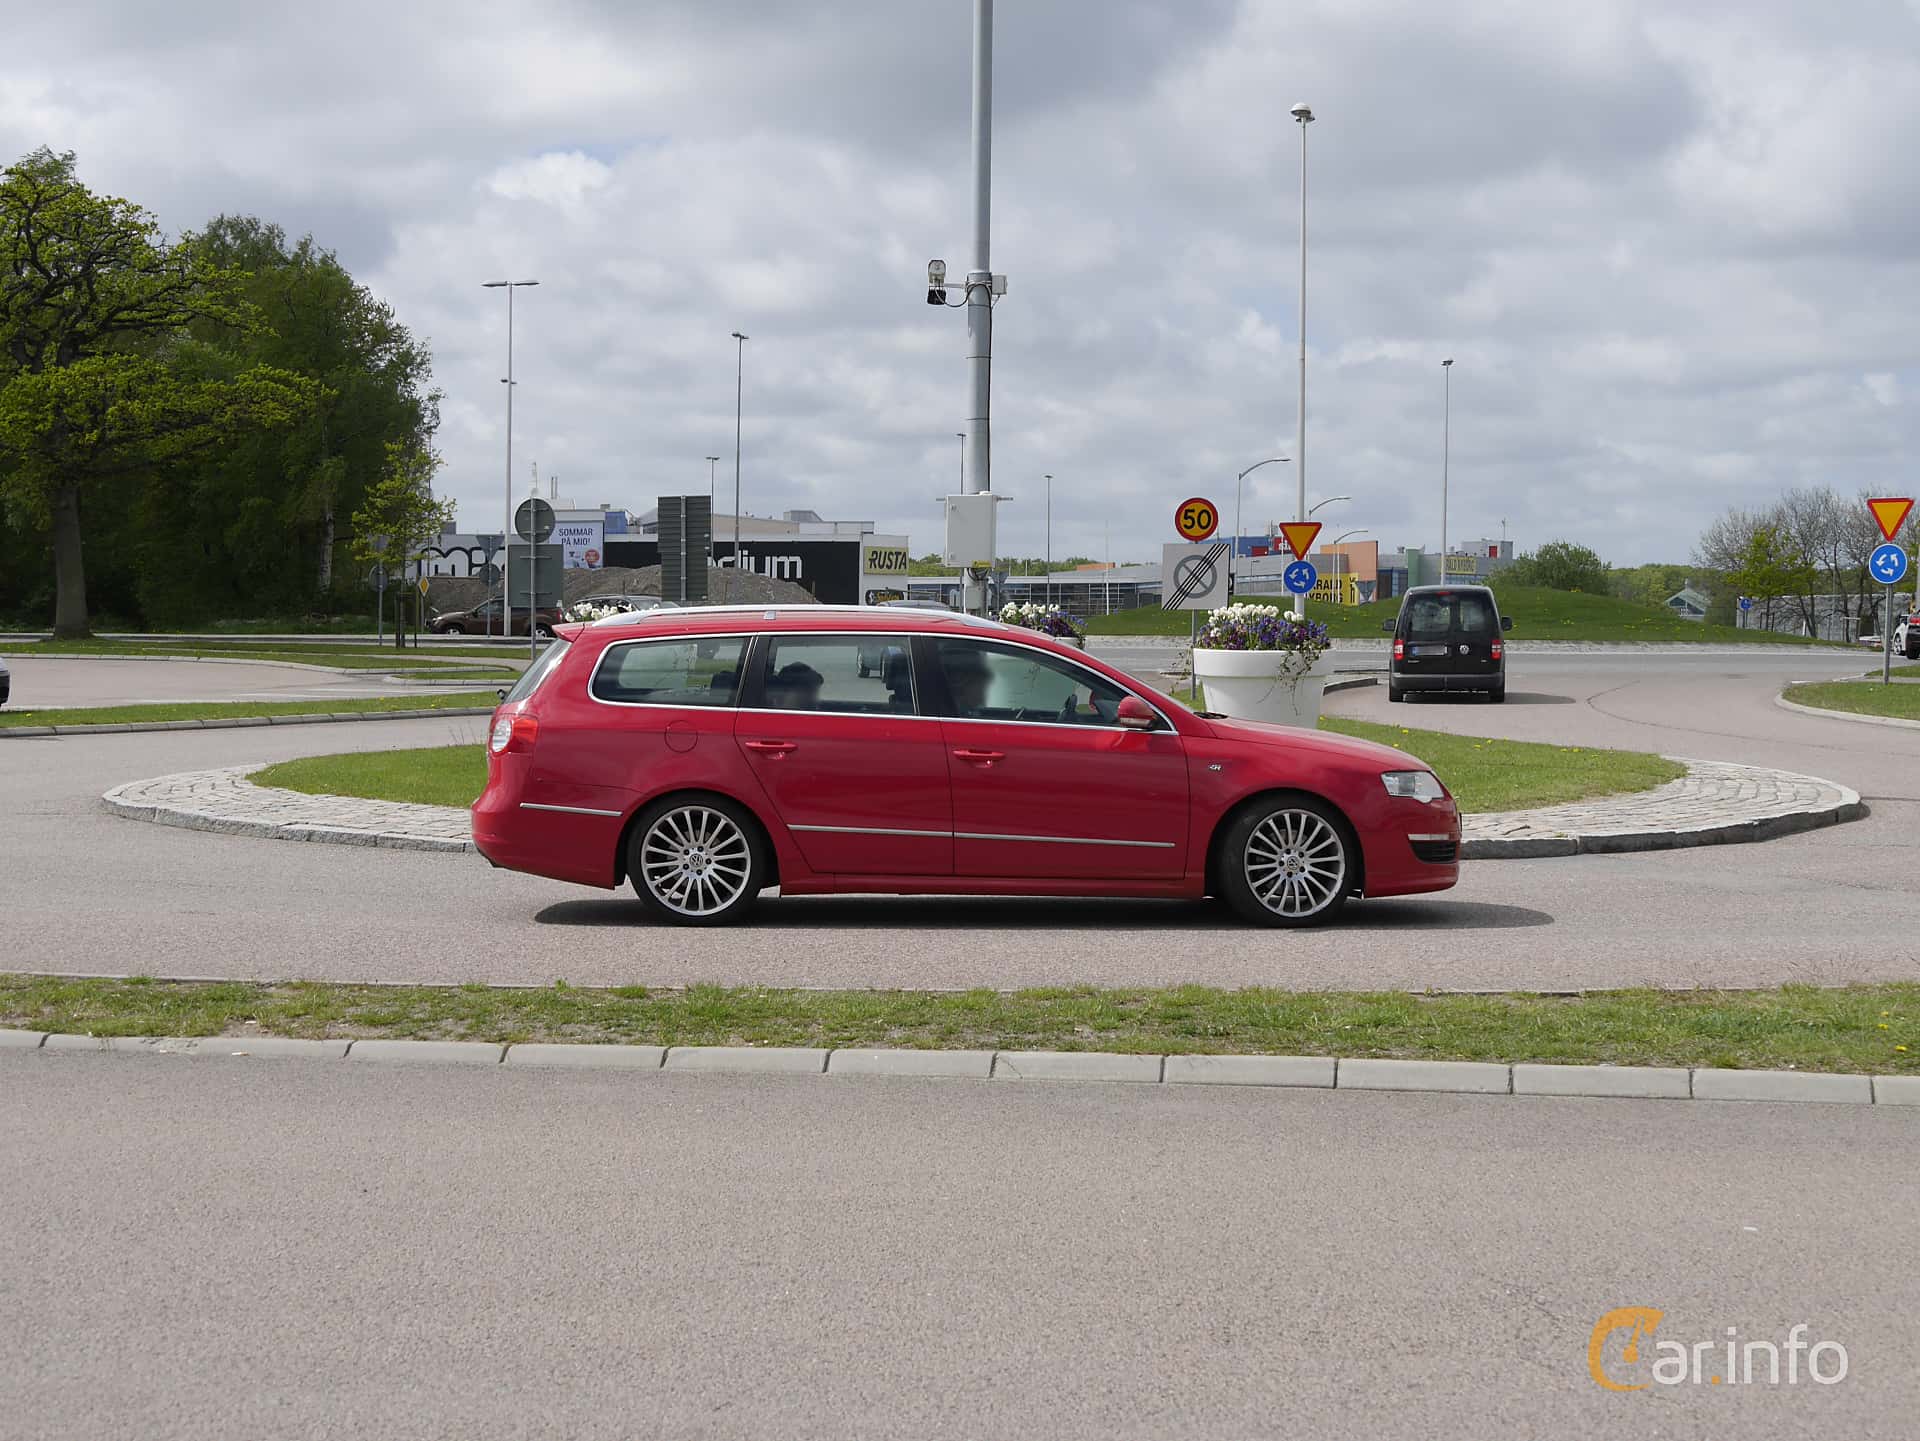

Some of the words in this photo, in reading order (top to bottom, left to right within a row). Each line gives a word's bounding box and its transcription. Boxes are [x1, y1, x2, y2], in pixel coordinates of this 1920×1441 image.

[1183, 509, 1212, 530] 50
[558, 527, 593, 537] SOMMAR
[868, 550, 907, 570] RUSTA
[1313, 579, 1343, 590] RALD
